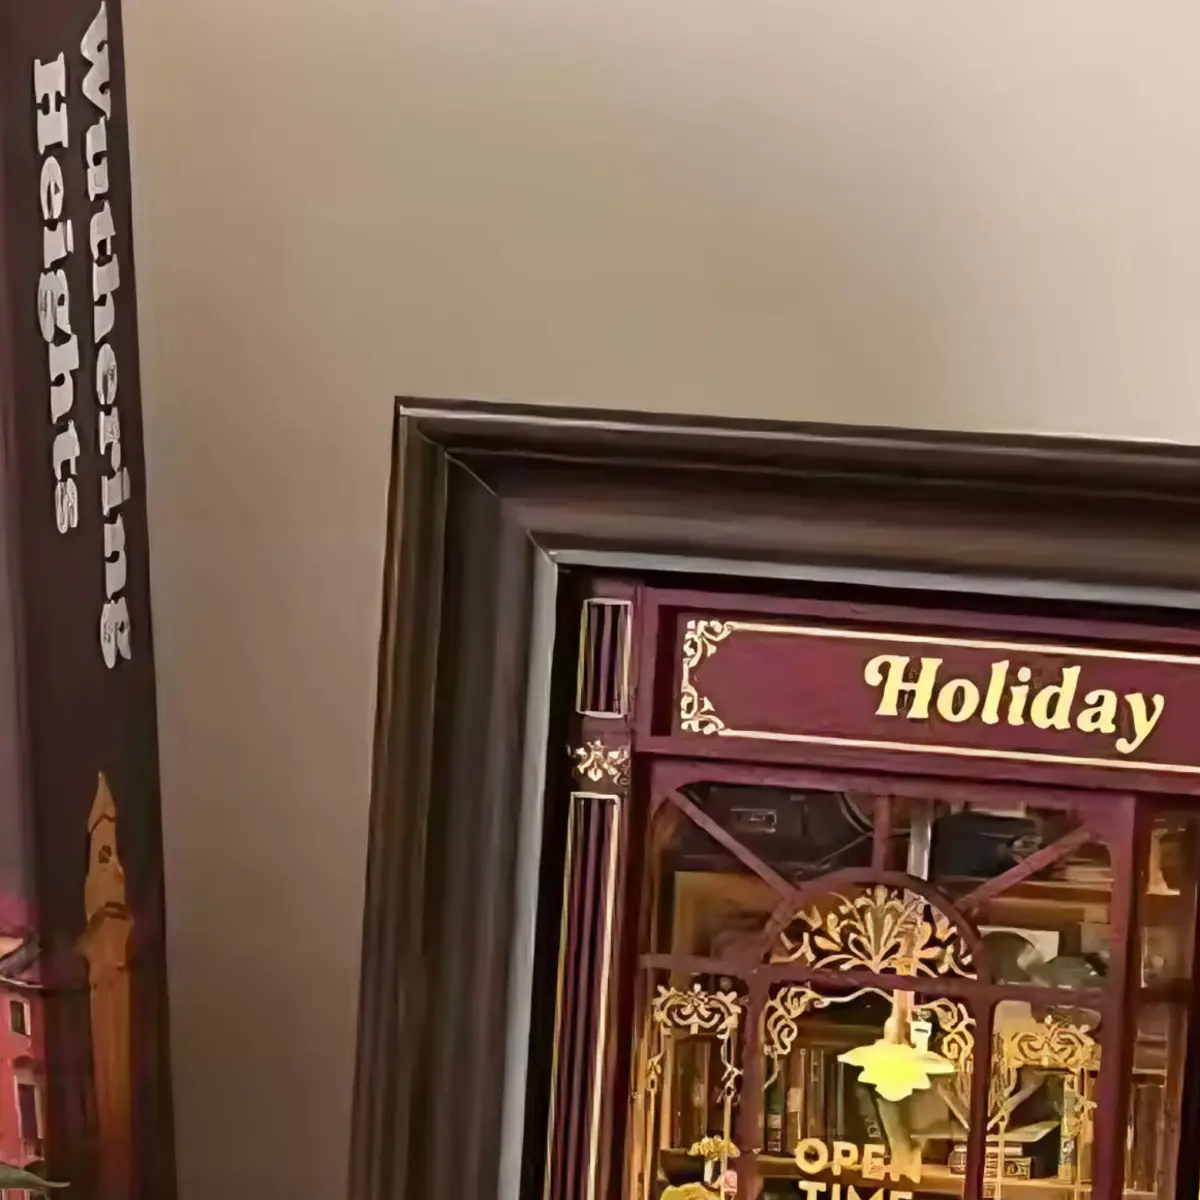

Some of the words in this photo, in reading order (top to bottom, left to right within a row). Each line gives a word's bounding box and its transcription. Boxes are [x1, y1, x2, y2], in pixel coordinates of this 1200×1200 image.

[34, 52, 80, 534] Heights
[80, 3, 132, 669] Wuthering
[864, 653, 1165, 755] Holiday
[795, 1137, 923, 1184] OPEN
